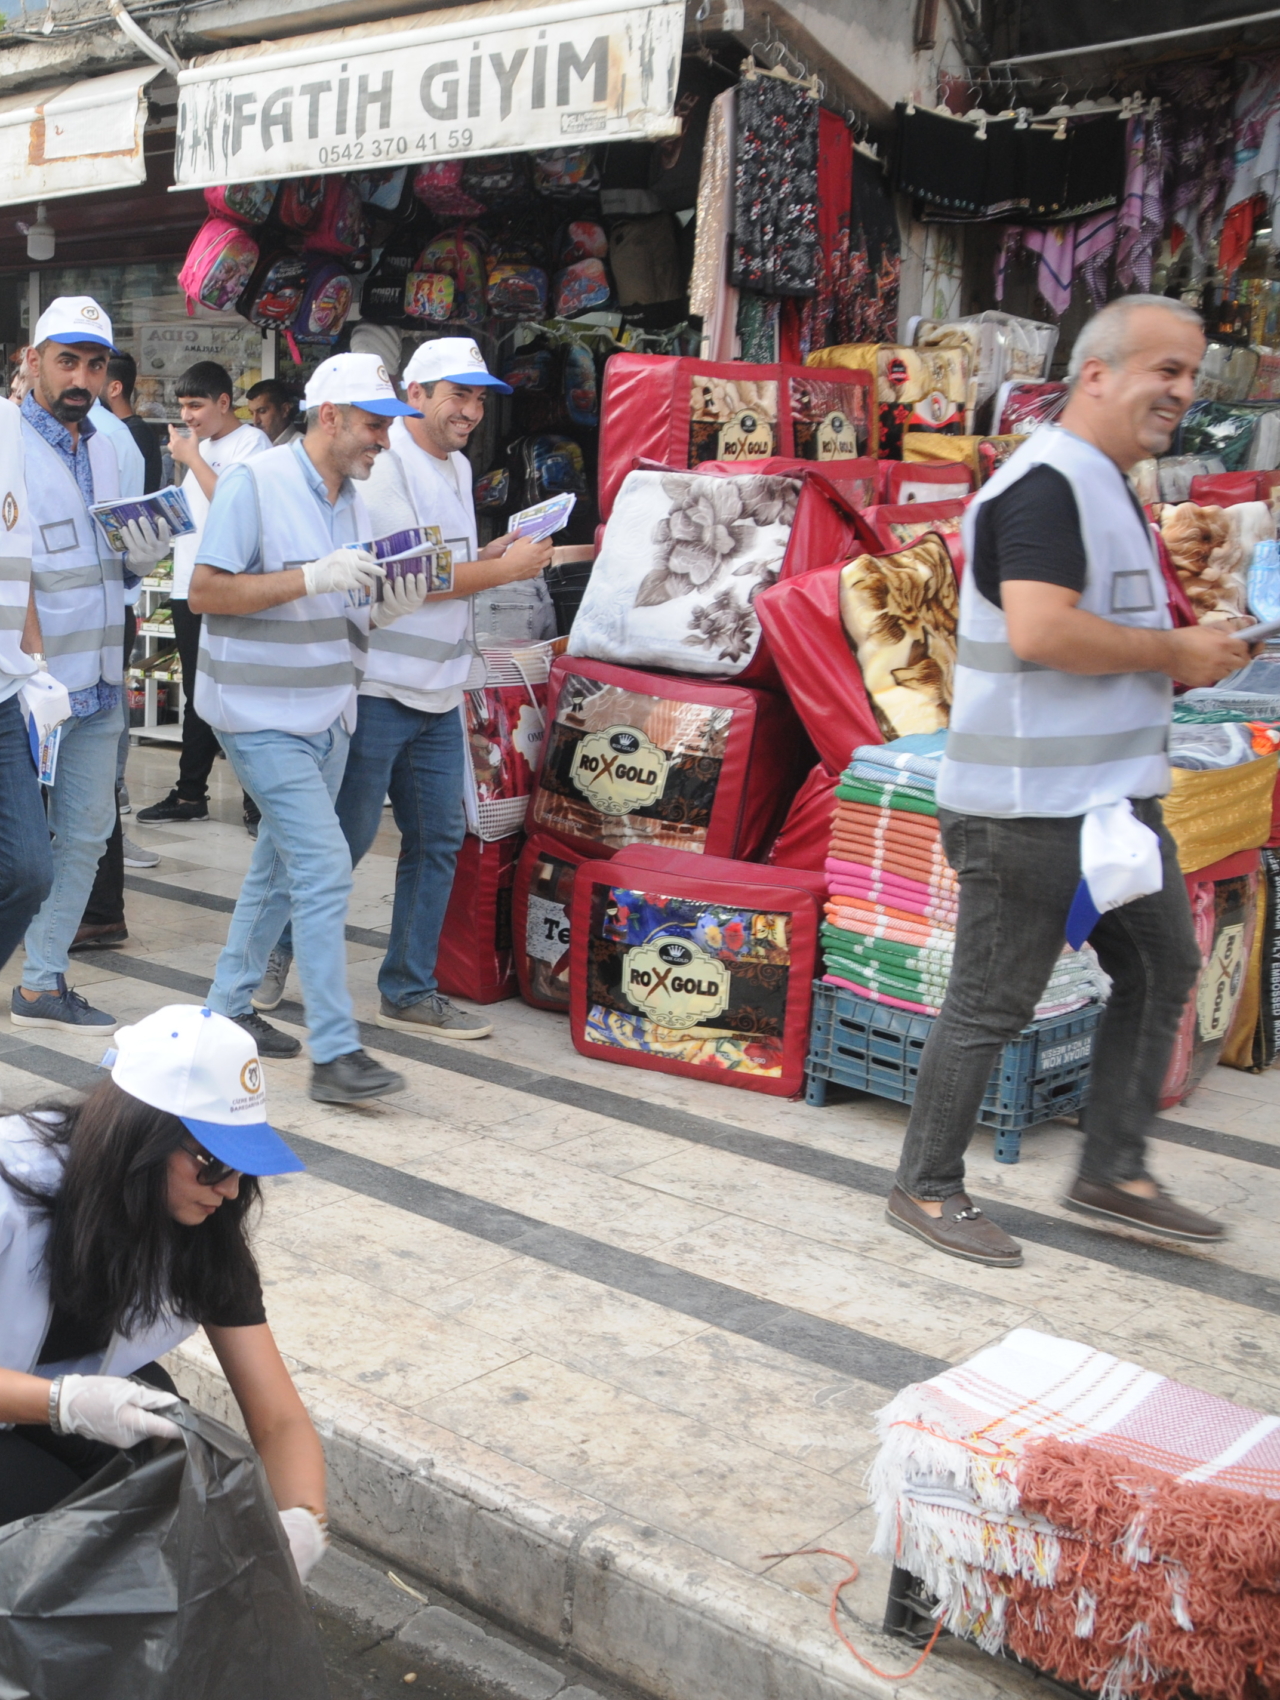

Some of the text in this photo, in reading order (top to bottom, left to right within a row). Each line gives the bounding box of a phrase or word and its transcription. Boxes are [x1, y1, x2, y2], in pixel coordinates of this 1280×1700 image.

[231, 62, 395, 157] FATİH
[419, 29, 610, 122] GİYİM
[318, 128, 474, 164] 0542 370 41 59
[1062, 1044, 1091, 1064] BUDAK
